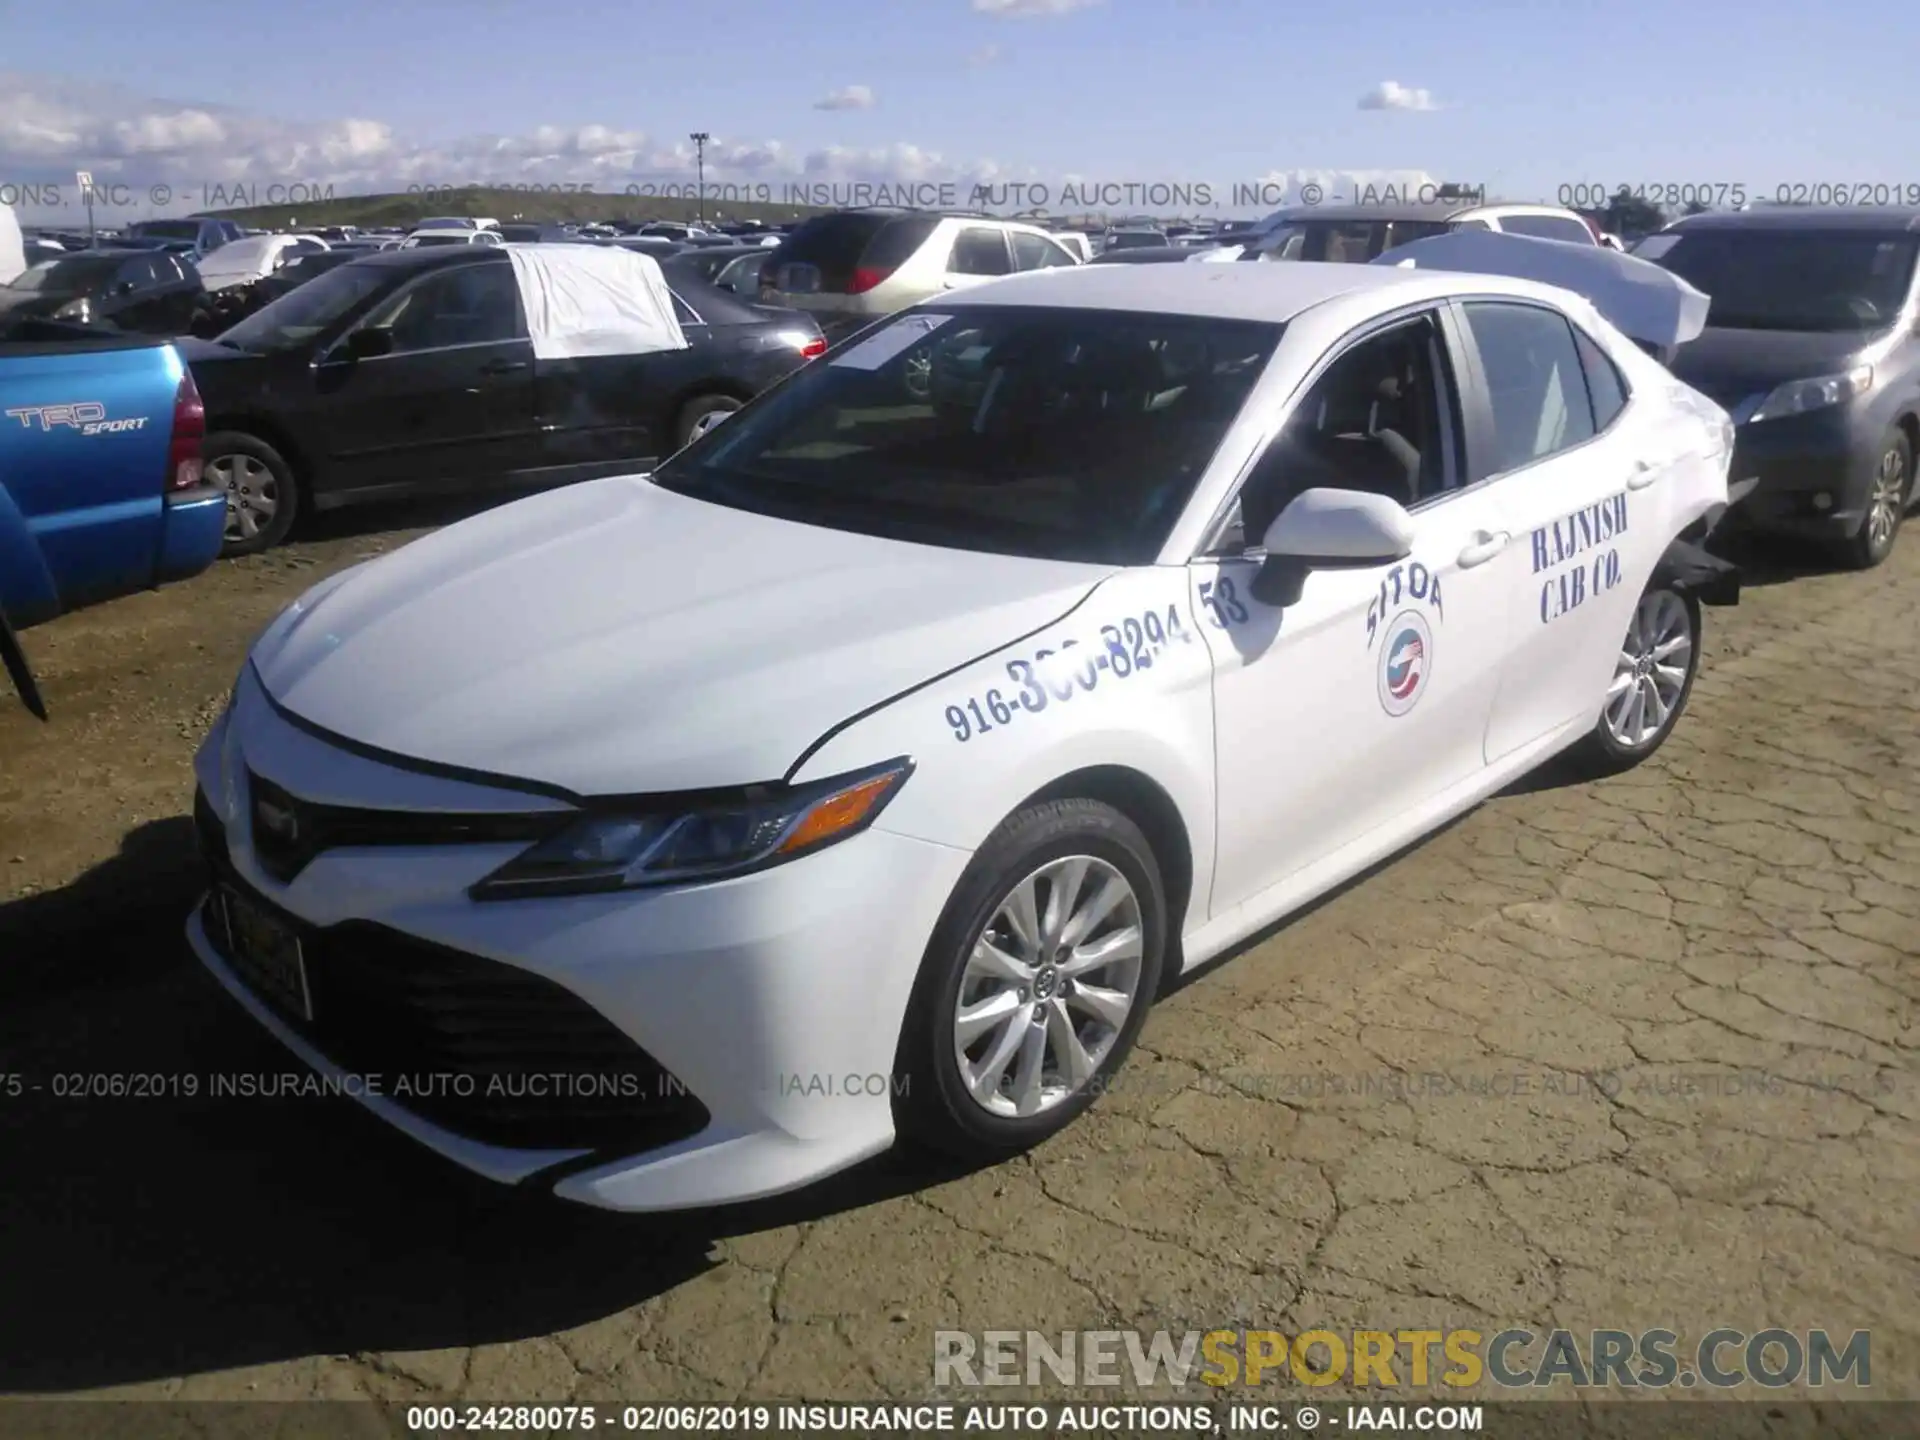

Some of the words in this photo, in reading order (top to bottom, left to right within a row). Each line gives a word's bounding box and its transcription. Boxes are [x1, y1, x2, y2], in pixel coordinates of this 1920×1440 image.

[5, 402, 105, 432] TRD
[82, 417, 149, 435] SPORT
[1531, 492, 1628, 574] RAJNISH
[1199, 577, 1249, 629] 53
[1367, 562, 1443, 651] SITOA
[1540, 564, 1586, 624] CAB
[1593, 548, 1623, 597] CO.
